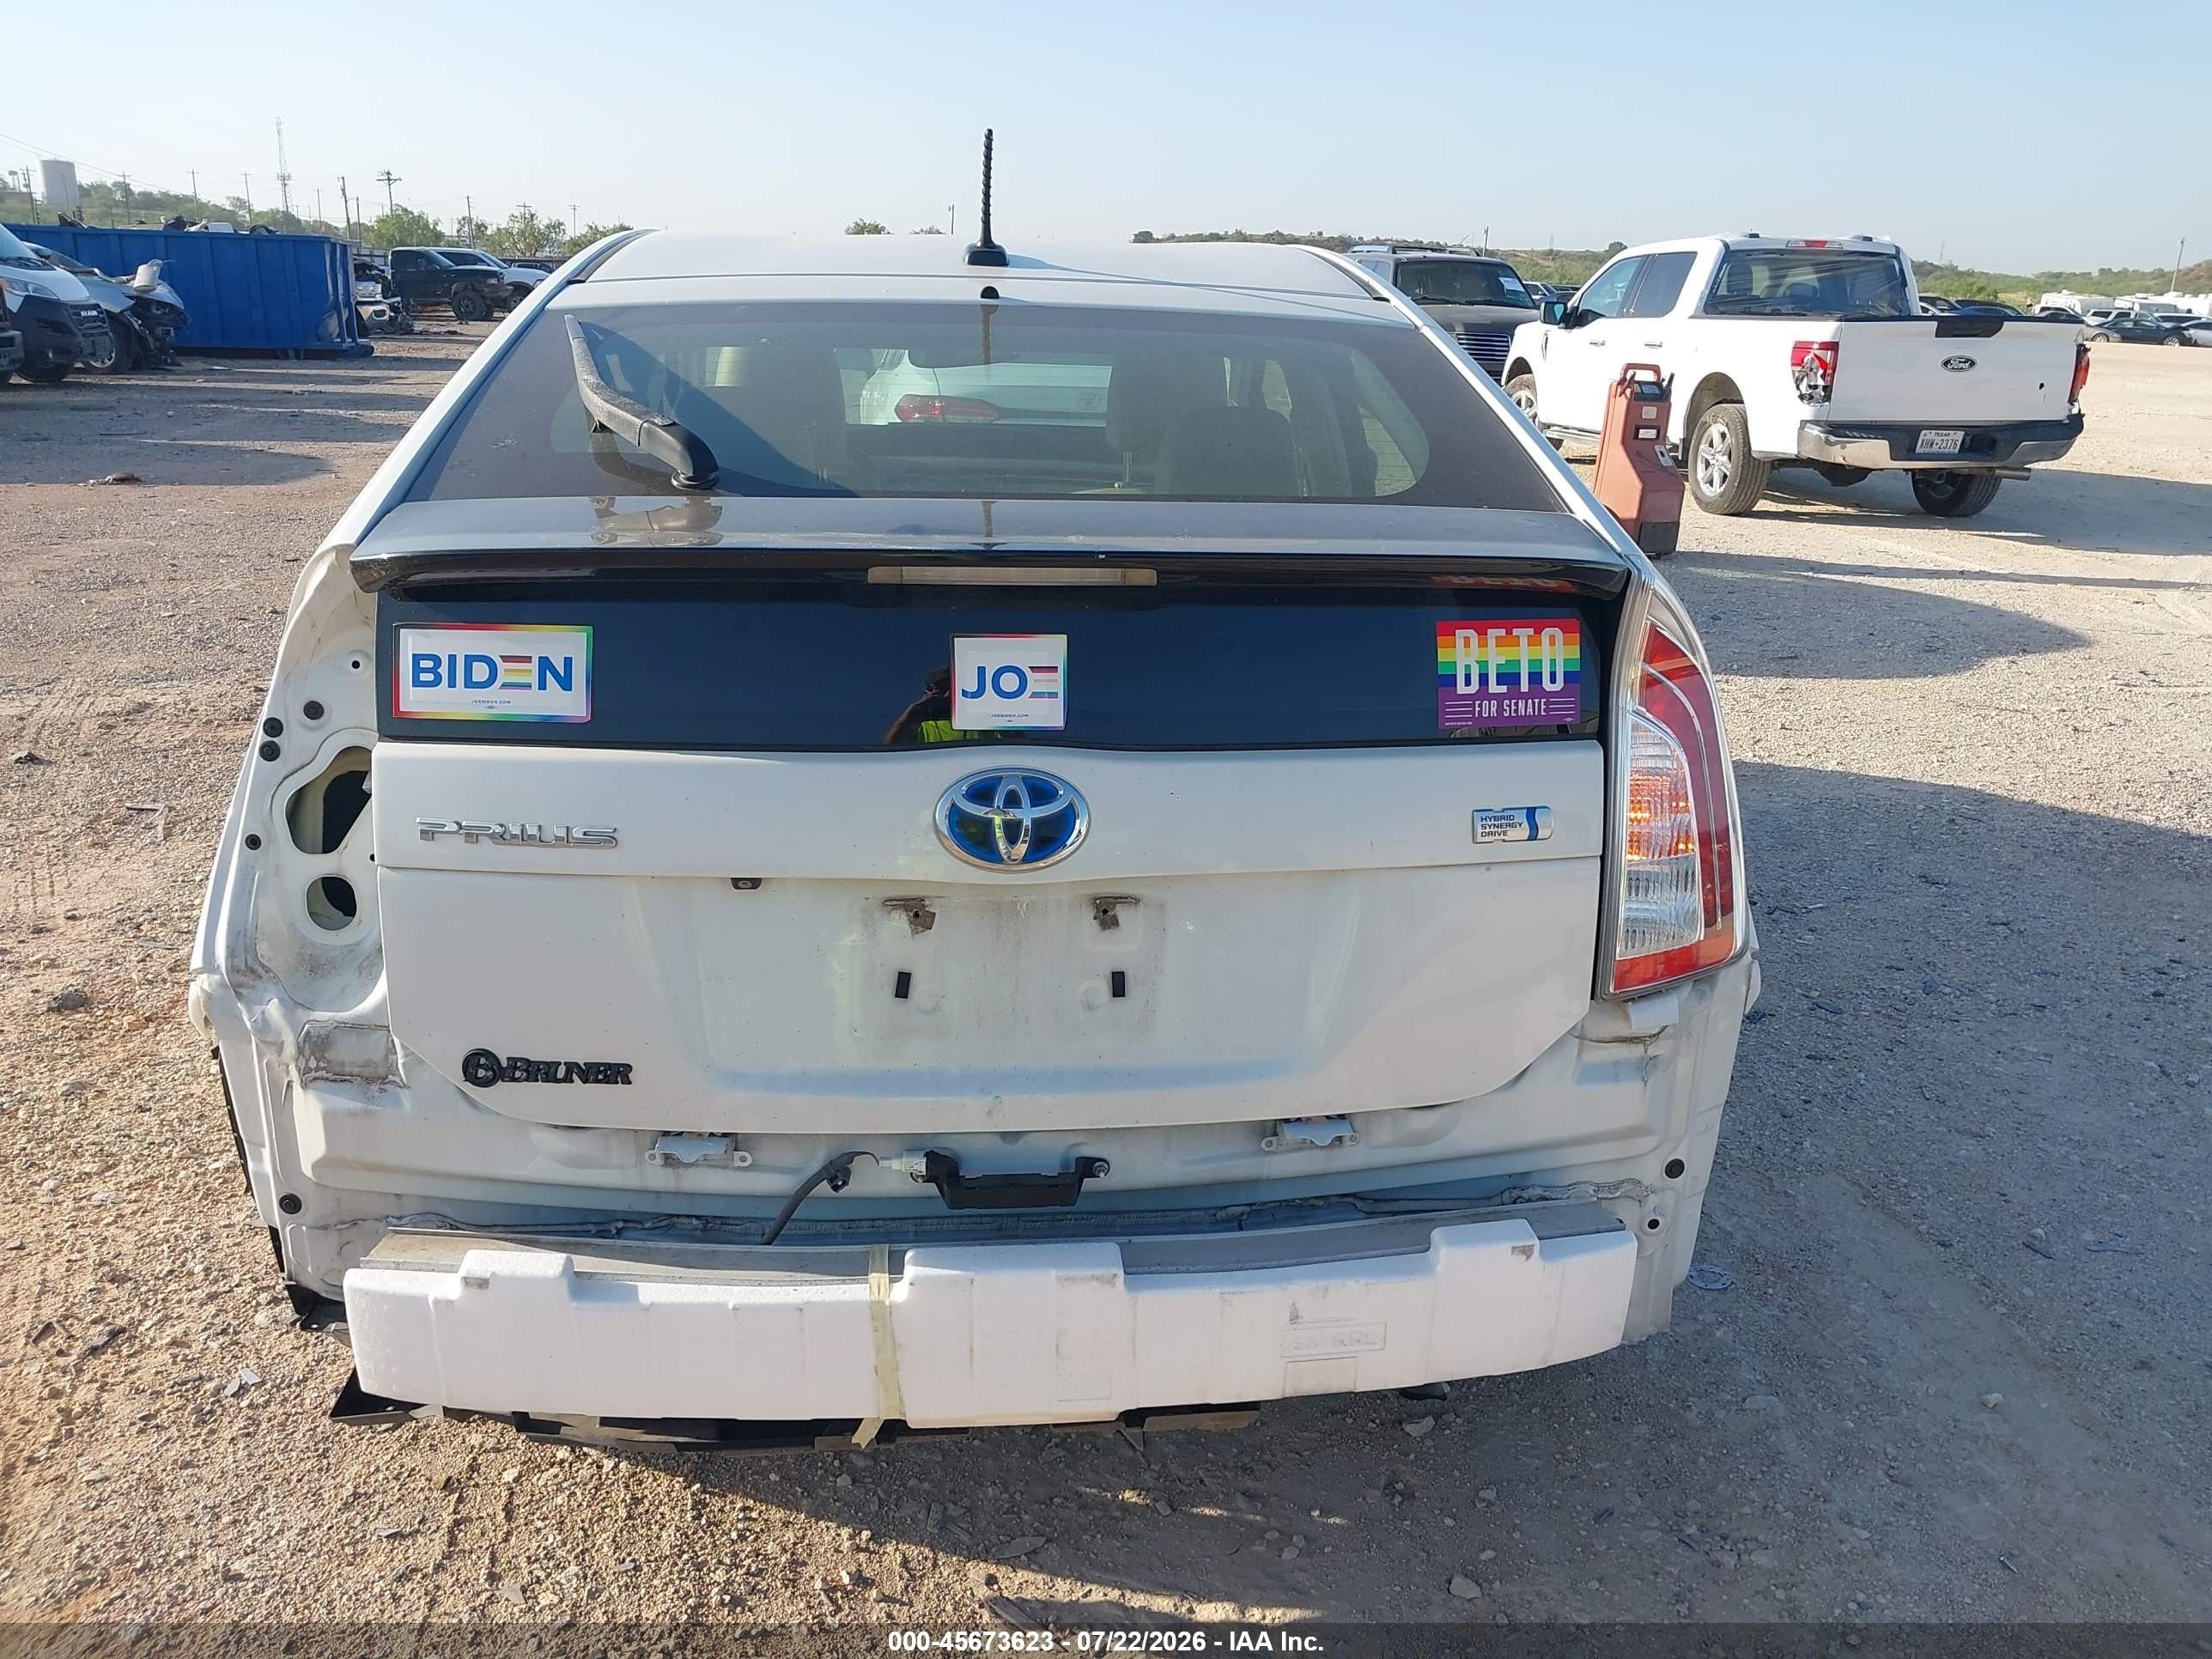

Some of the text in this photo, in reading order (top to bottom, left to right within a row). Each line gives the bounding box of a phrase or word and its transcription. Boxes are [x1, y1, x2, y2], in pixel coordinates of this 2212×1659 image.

[1947, 357, 1971, 369] Ford
[411, 653, 573, 691] BIDEN
[1455, 627, 1565, 695] BETO
[962, 665, 1059, 700] JOE
[1474, 698, 1547, 718] FOR SENATE
[1480, 814, 1515, 823] HYBRID
[1480, 822, 1523, 830] SYNERGY
[415, 817, 618, 848] PRIUS
